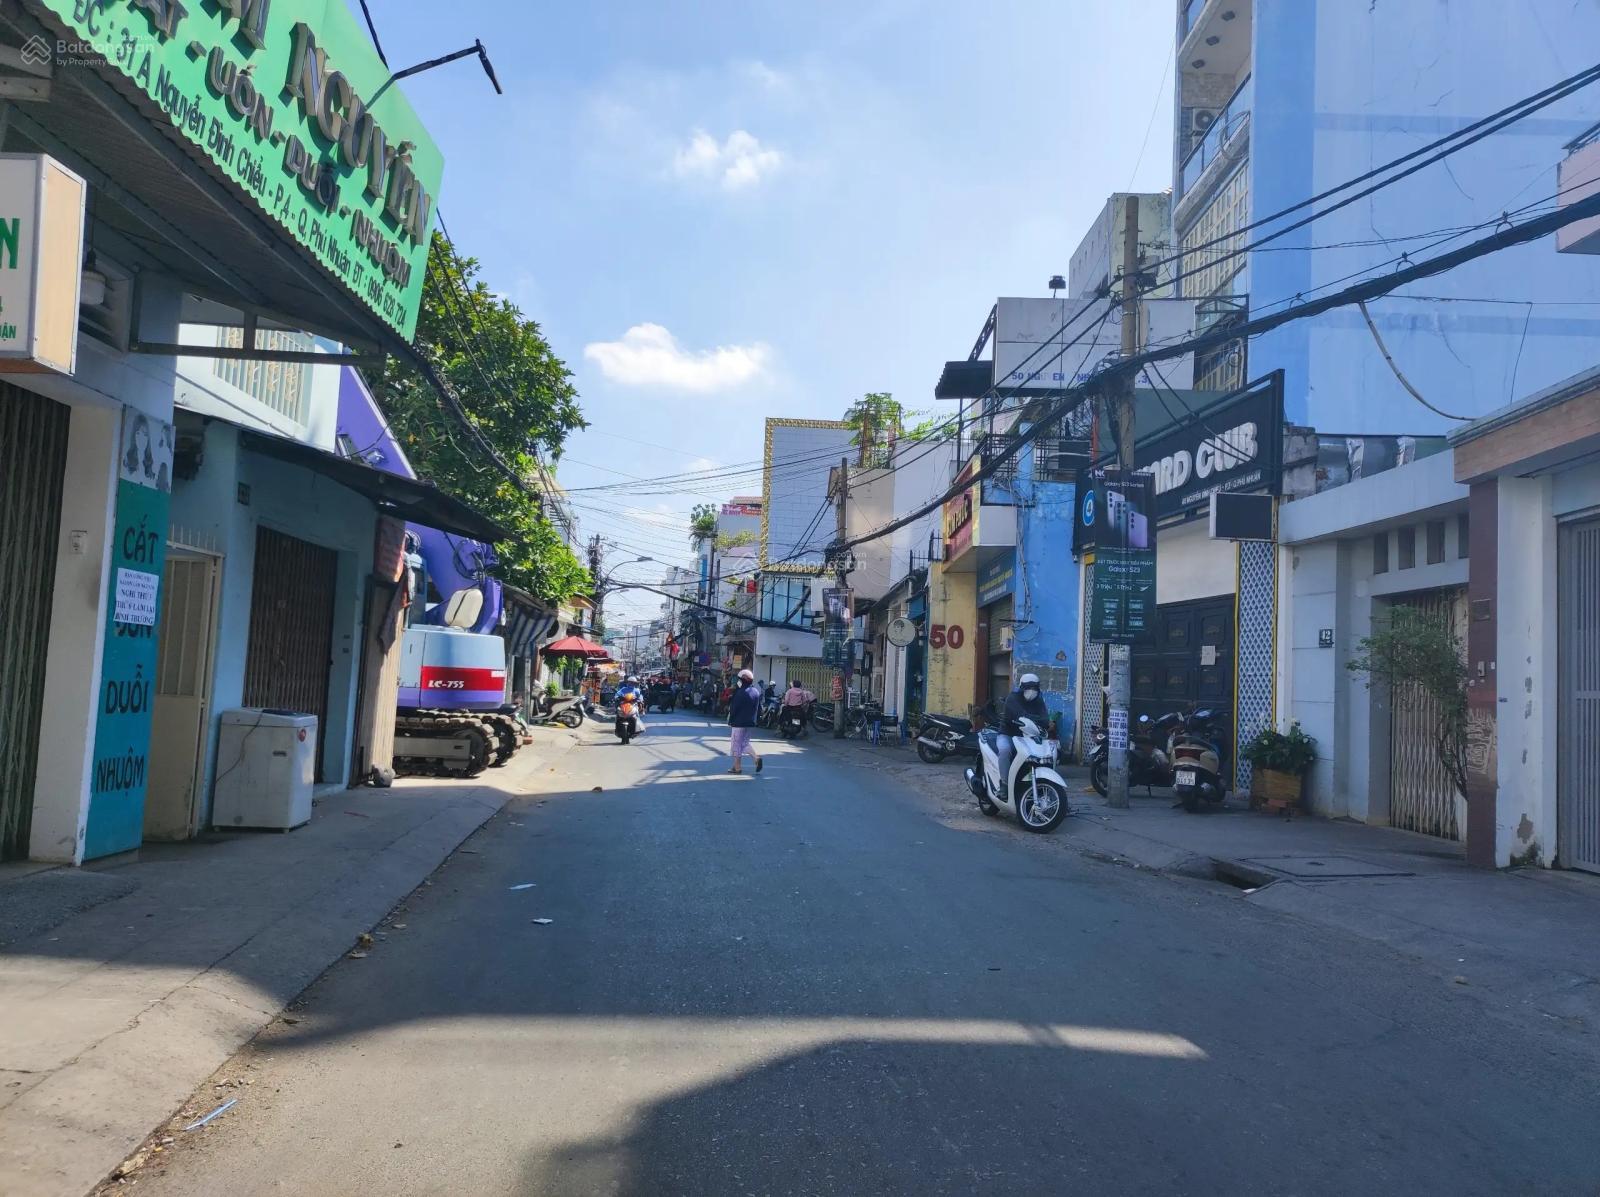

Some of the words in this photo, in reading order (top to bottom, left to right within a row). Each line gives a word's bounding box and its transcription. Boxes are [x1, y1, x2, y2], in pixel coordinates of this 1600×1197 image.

[1196, 422, 1258, 478] CLUB
[123, 514, 158, 563] CẮT
[929, 624, 964, 649] 50
[105, 663, 150, 714] DUỖI
[95, 745, 145, 797] NHUỘM
